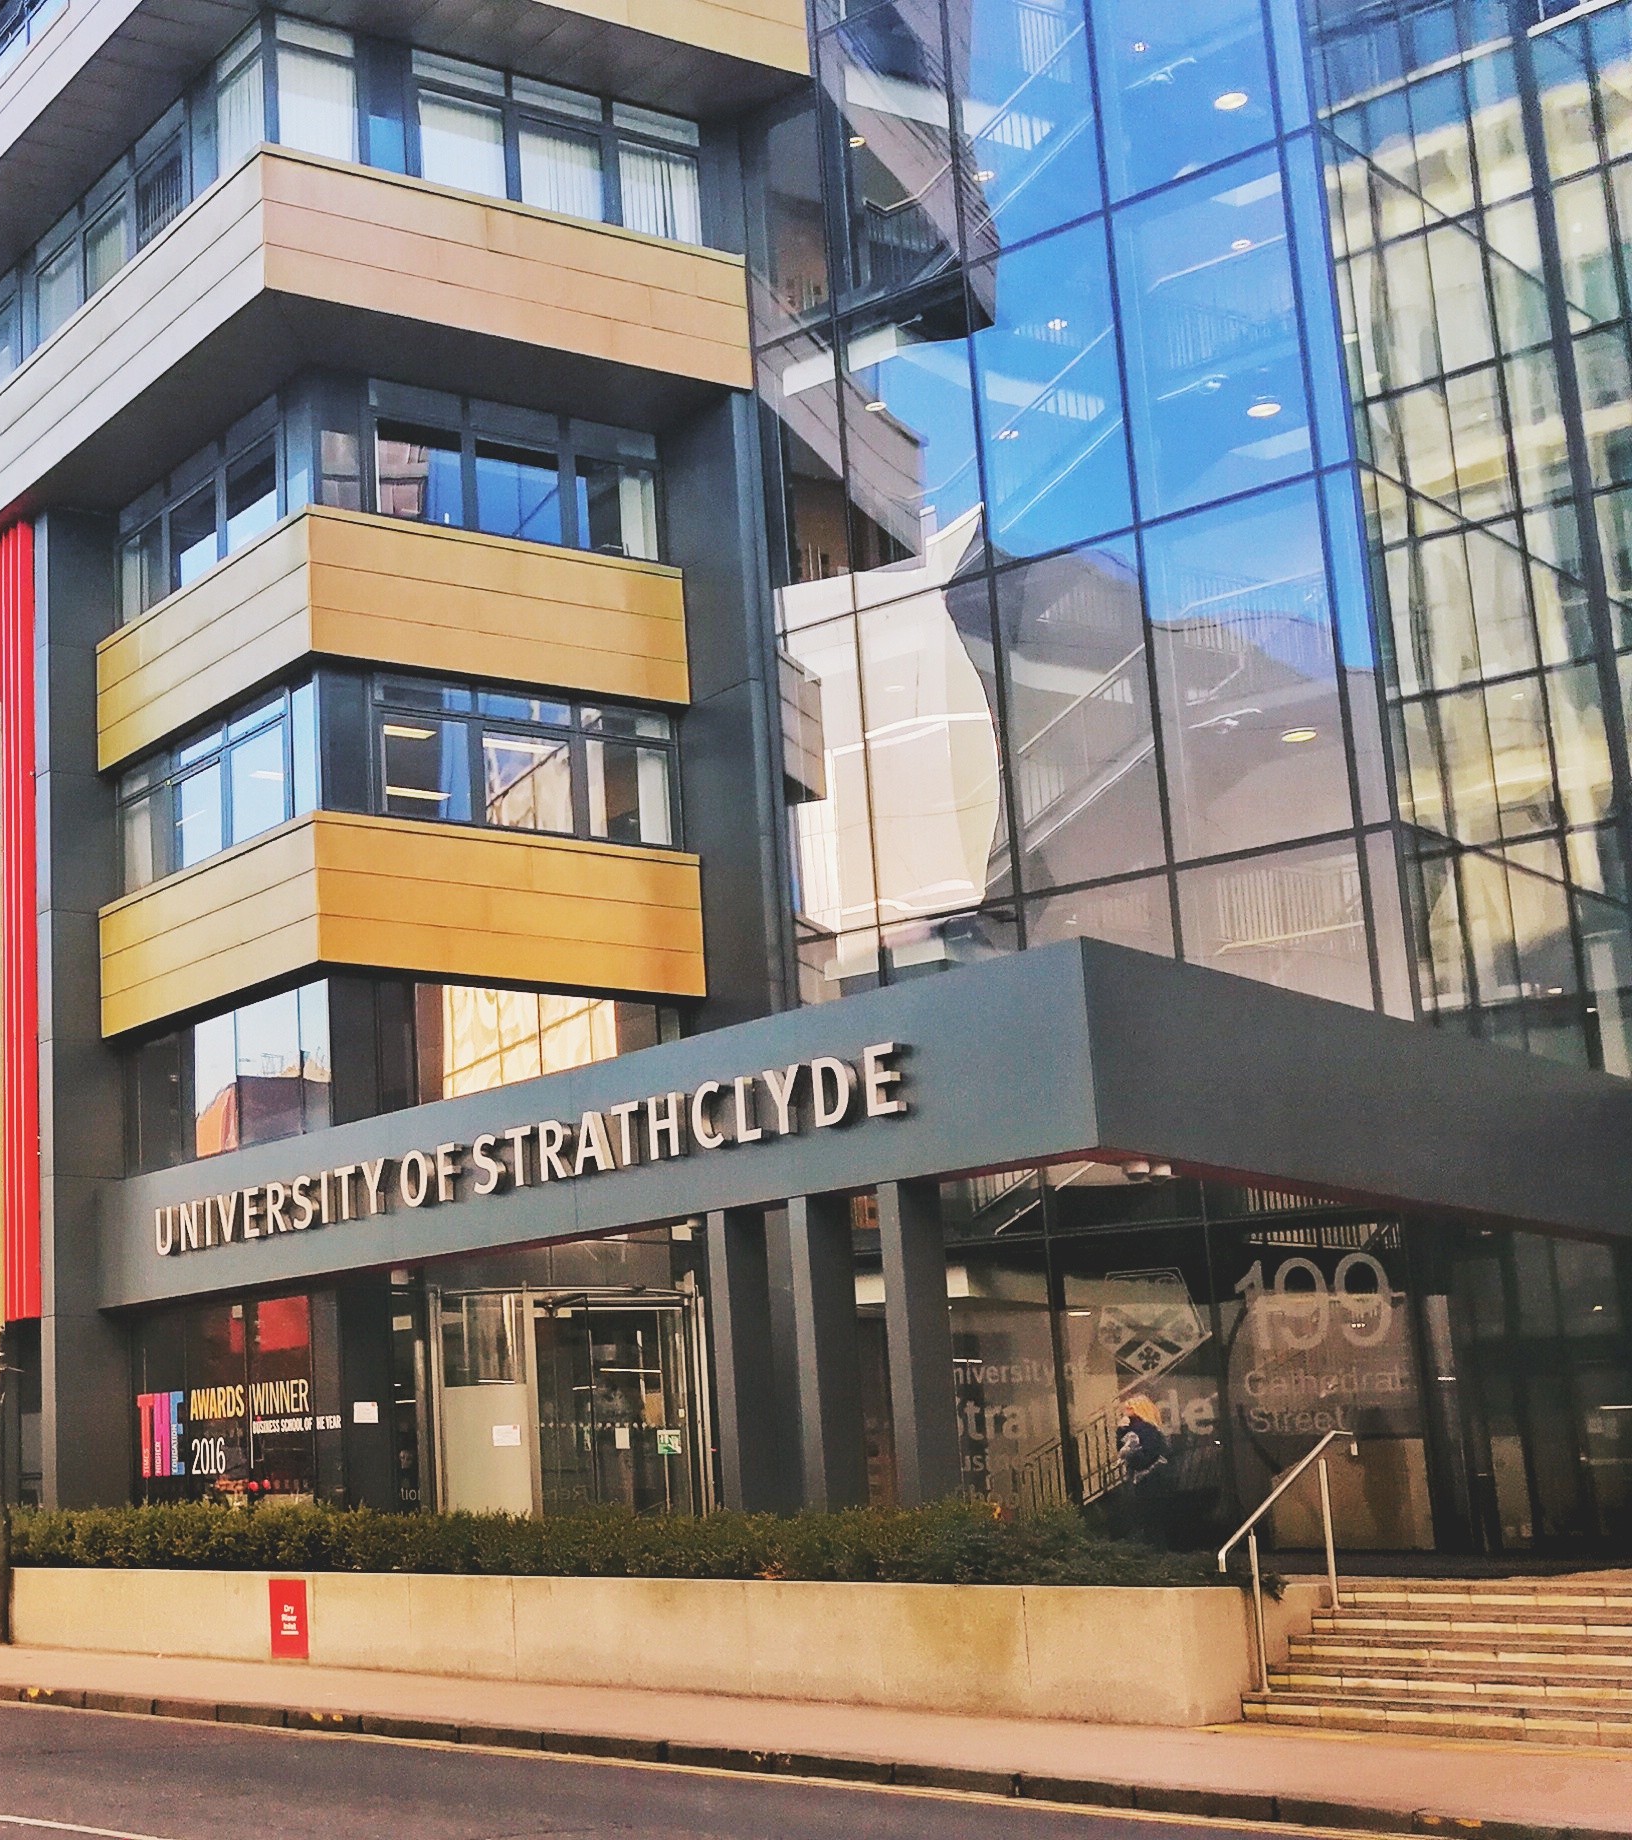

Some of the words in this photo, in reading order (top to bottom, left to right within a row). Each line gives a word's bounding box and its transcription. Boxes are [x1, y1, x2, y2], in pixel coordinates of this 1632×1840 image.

[154, 1157, 388, 1257] UNIVERSITY
[399, 1142, 465, 1208] OF
[471, 1041, 908, 1196] STRATHCLYDE
[1234, 1252, 1393, 1350] 199
[954, 1358, 1055, 1388] niversity
[1244, 1363, 1404, 1397] Cathedral
[190, 1384, 245, 1421] AWARDS
[252, 1379, 310, 1415] WINNER
[137, 1391, 185, 1477] THE
[253, 1419, 280, 1434] BUSINESS
[280, 1417, 304, 1432] SCHOOL
[304, 1416, 313, 1431] OF
[316, 1416, 326, 1430] HE
[326, 1415, 342, 1429] YEAR
[1250, 1405, 1348, 1433] Street
[191, 1437, 226, 1475] 2016
[283, 1604, 294, 1614] Dry
